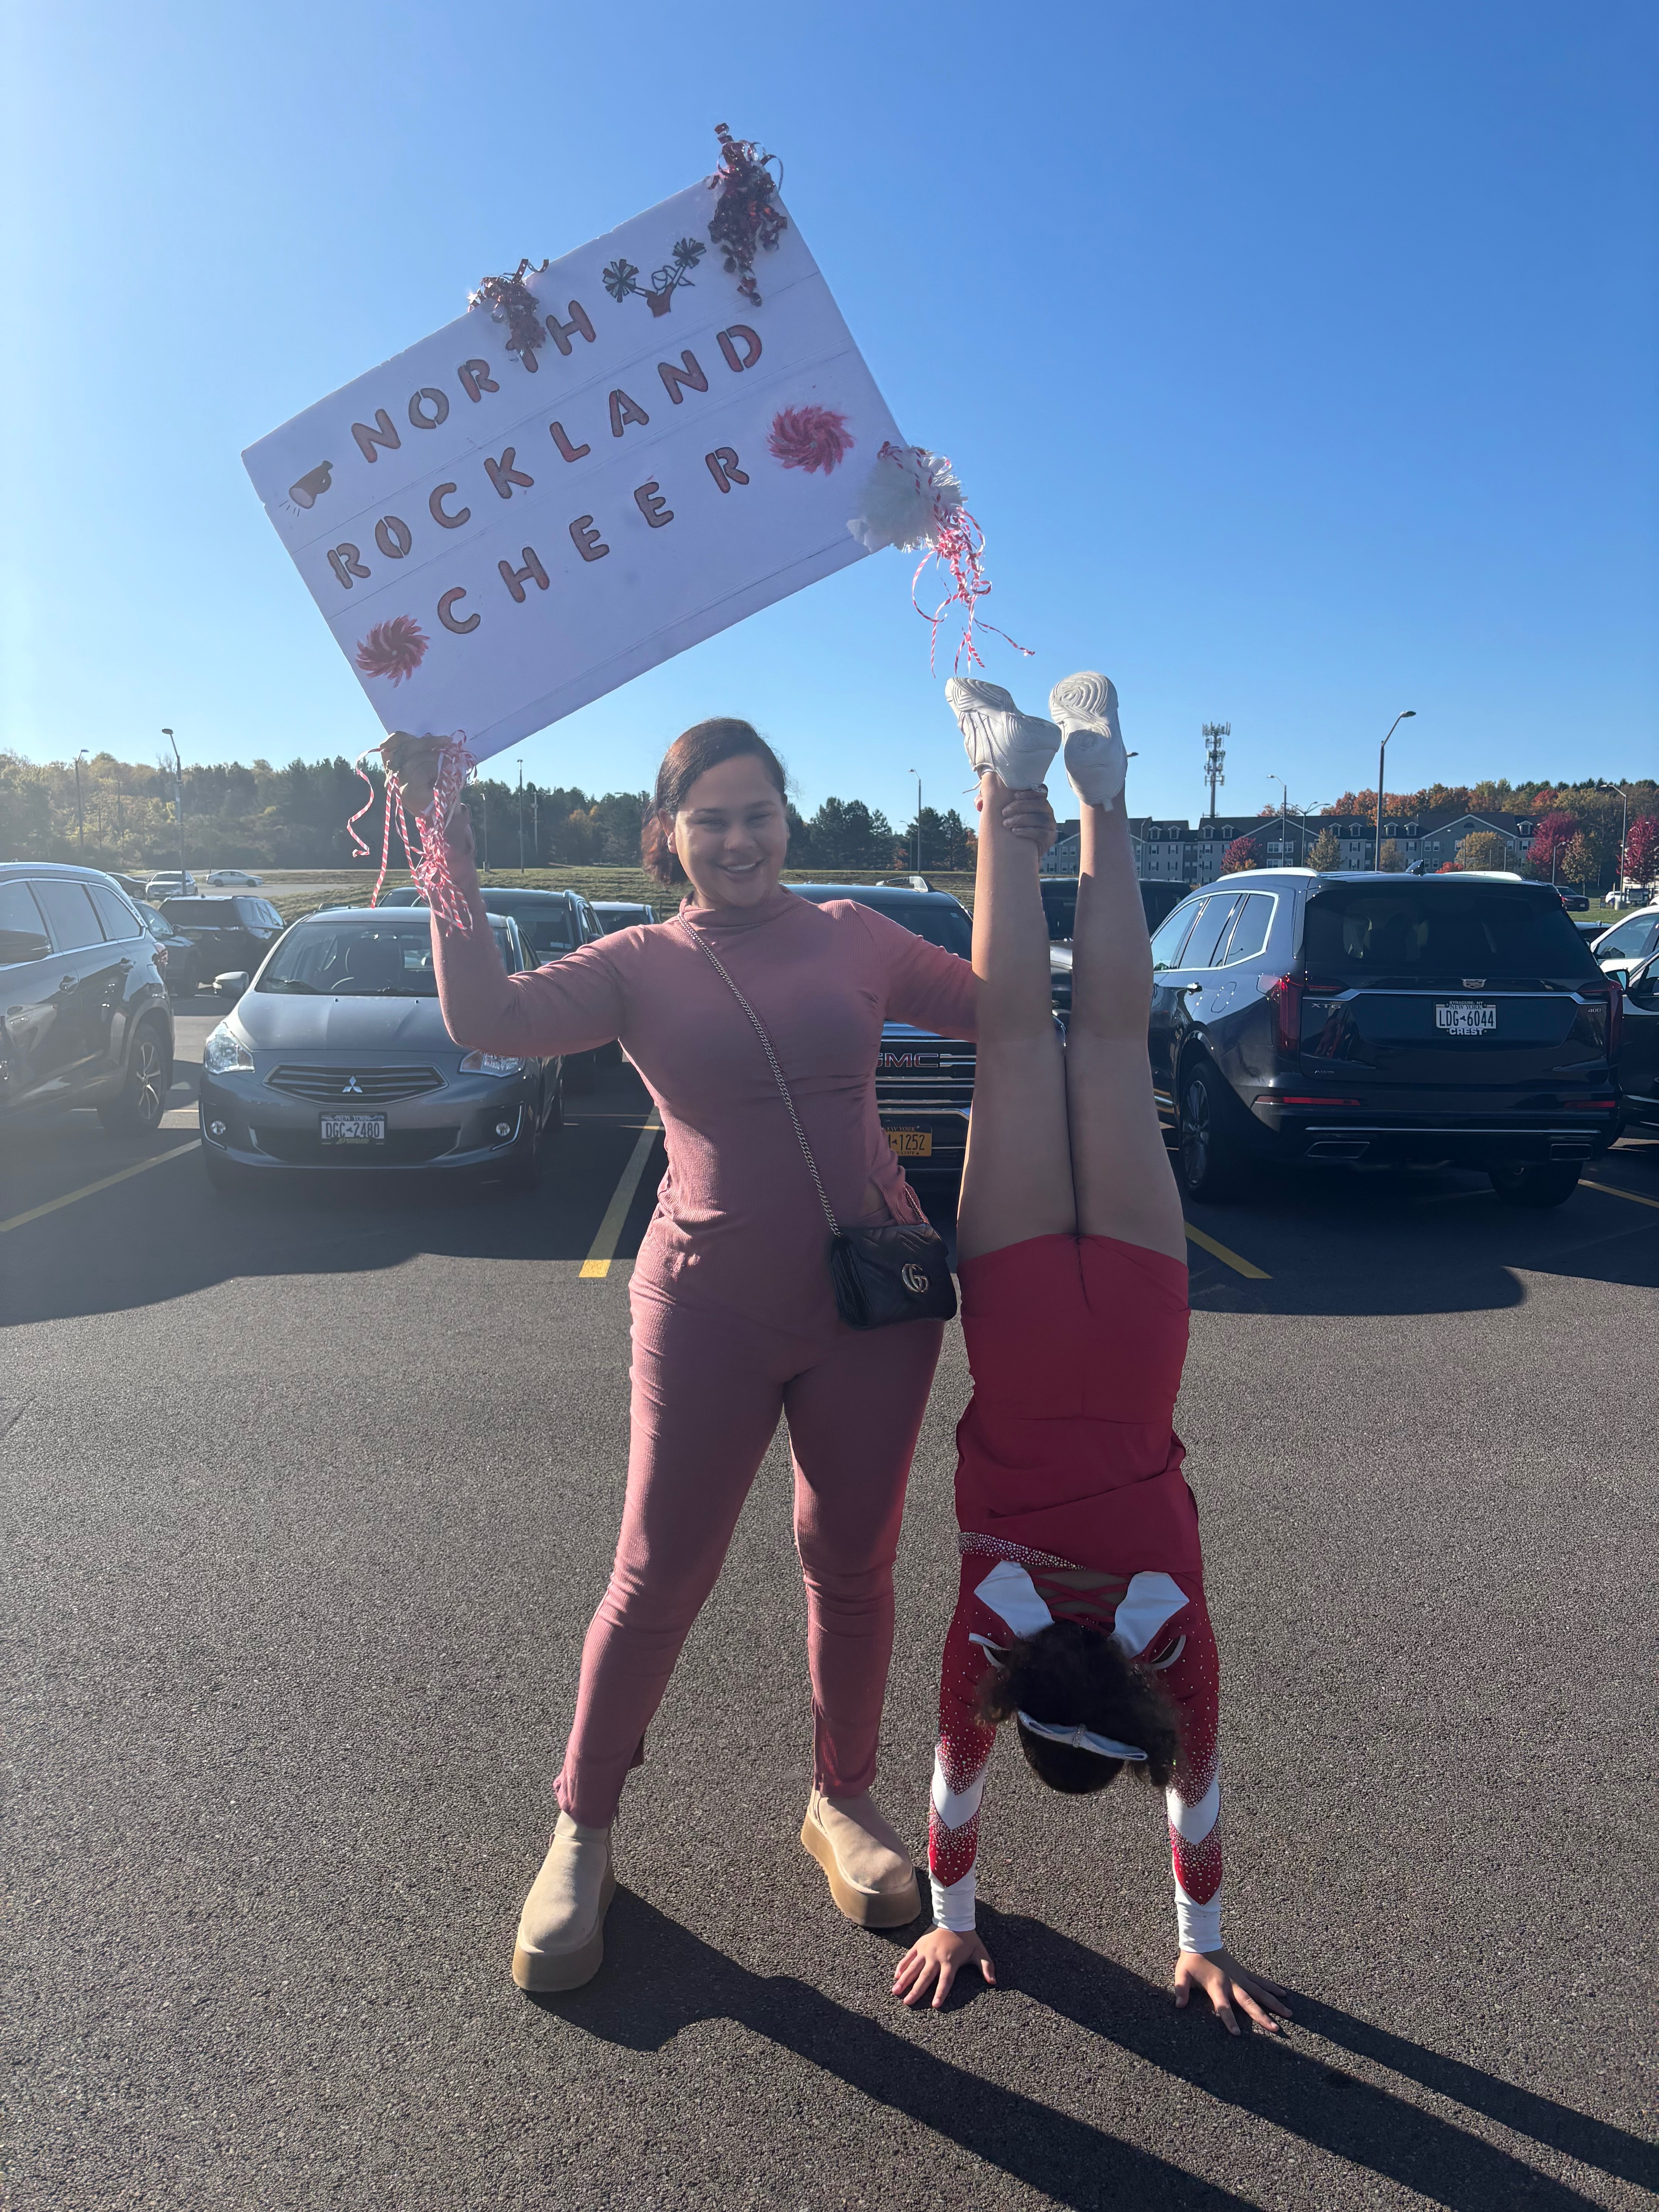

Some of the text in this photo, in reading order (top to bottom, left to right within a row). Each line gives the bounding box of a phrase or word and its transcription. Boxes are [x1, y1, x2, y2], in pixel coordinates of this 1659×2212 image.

[327, 324, 763, 589] ROCKLAND
[436, 446, 750, 635] CHEER
[1439, 1010, 1494, 1027] LDG 6044
